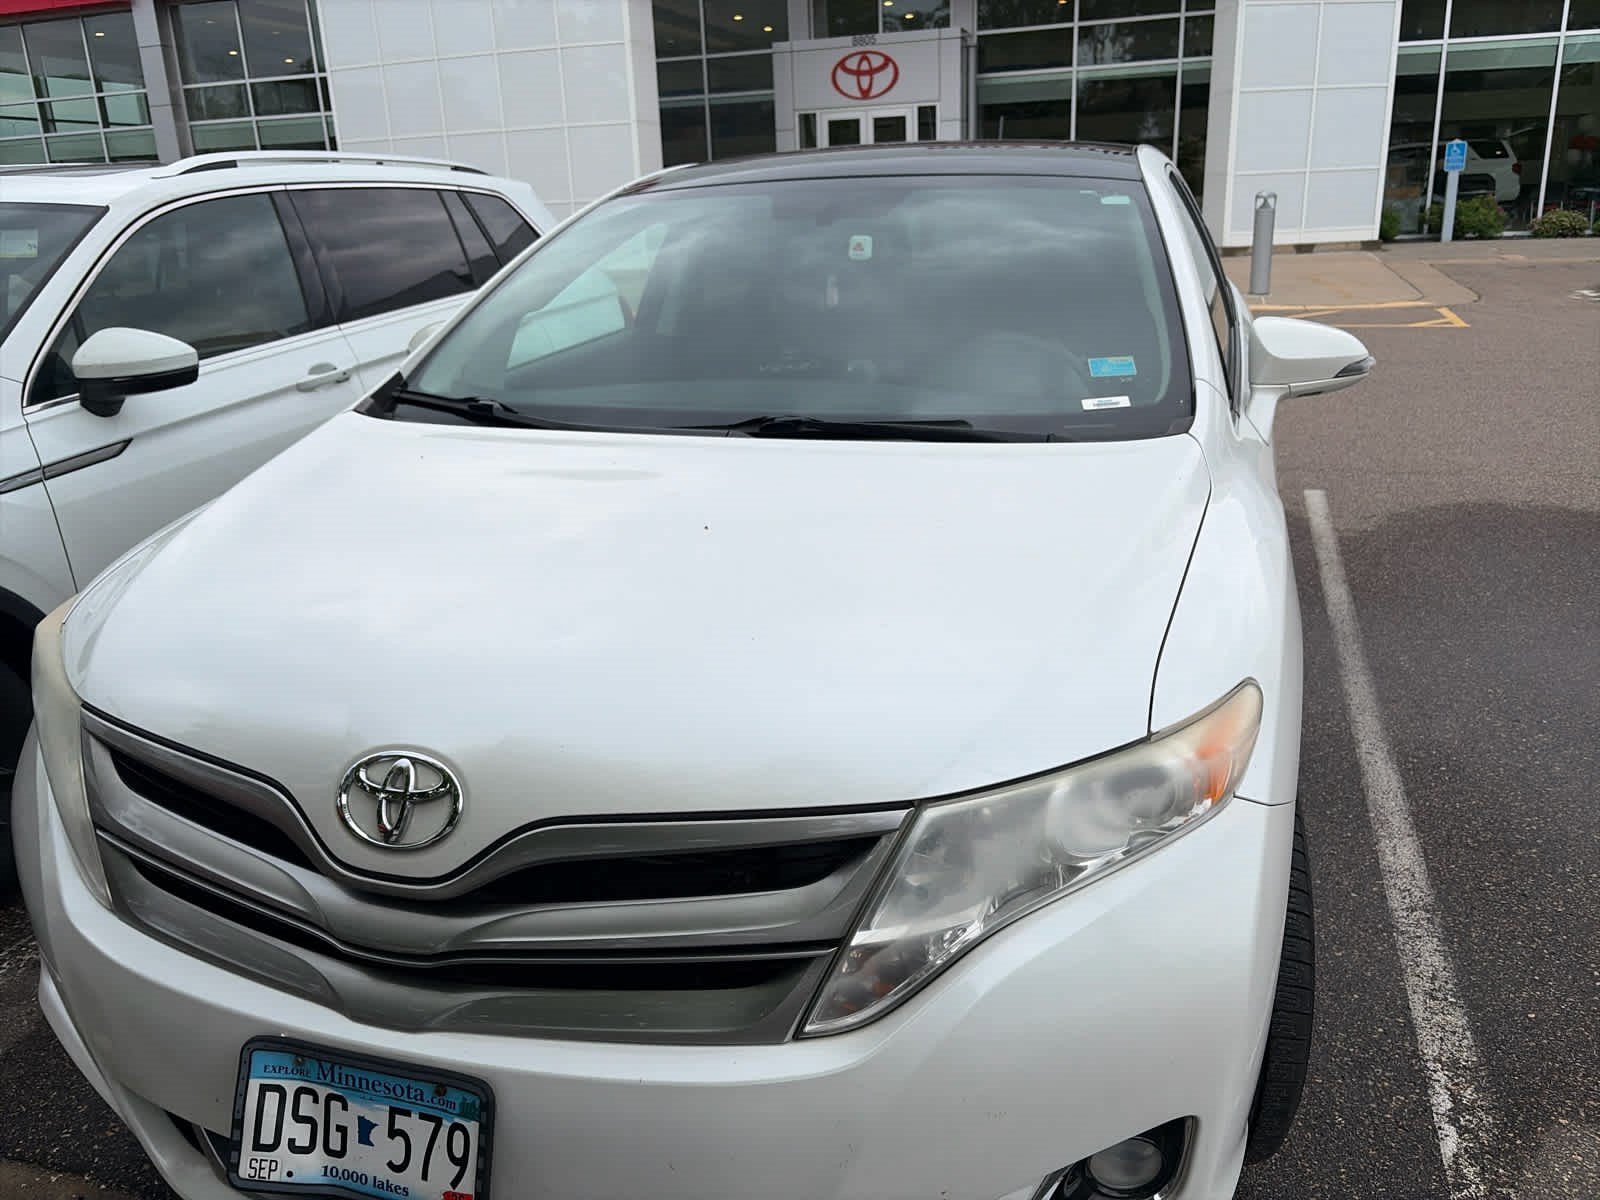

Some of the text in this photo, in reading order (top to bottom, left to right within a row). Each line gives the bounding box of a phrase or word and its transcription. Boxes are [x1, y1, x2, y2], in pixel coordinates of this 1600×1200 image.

[251, 1083, 471, 1190] DSG 579
[247, 1158, 278, 1180] SEP
[321, 1165, 409, 1197] 10,000 lakes
